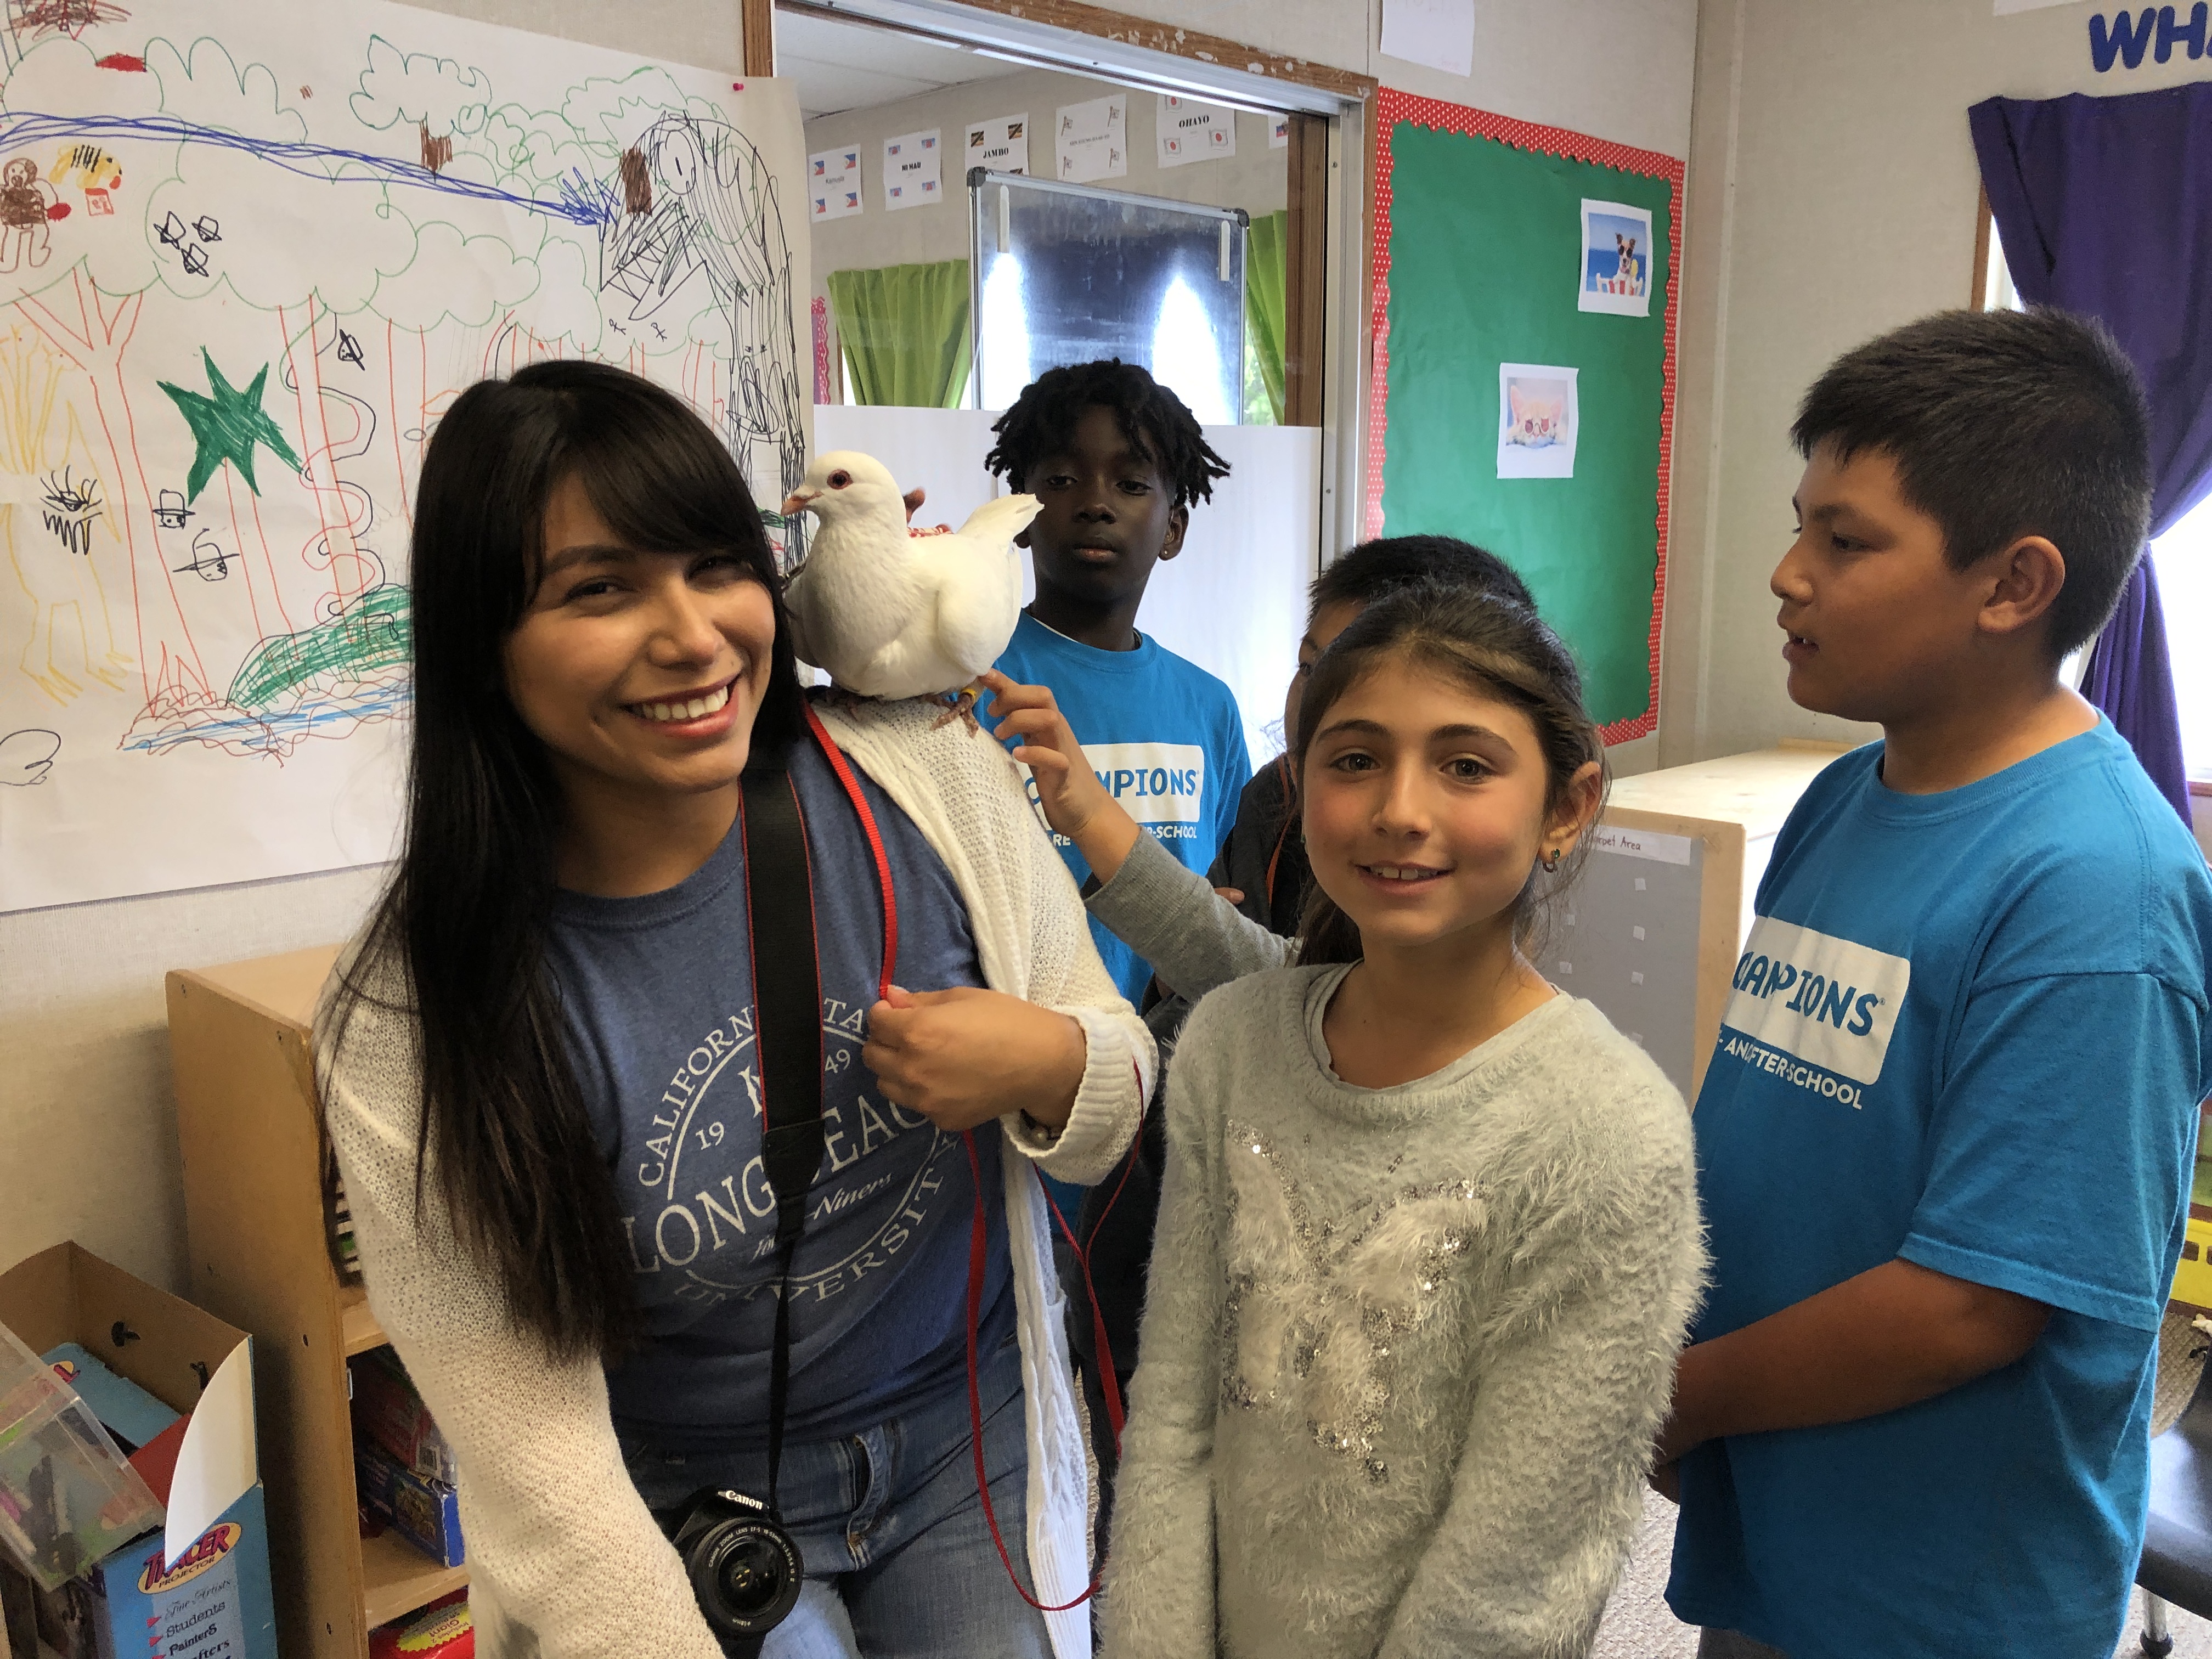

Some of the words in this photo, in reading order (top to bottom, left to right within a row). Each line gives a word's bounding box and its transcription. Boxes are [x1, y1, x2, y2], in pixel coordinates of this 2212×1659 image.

[2089, 1, 2212, 73] WH
[1178, 115, 1210, 128] OHAYO
[983, 147, 1009, 159] JAMBO
[1620, 836, 1641, 851] Area
[695, 1121, 725, 1150] 19
[620, 1155, 777, 1273] LONG
[725, 1490, 763, 1510] Canon
[708, 1547, 720, 1568] CANON
[719, 1533, 734, 1547] ZOOM
[735, 1527, 748, 1536] LENS
[159, 1556, 216, 1589] PROJECTOR
[166, 1601, 226, 1638] Students
[428, 1619, 460, 1638] Giant
